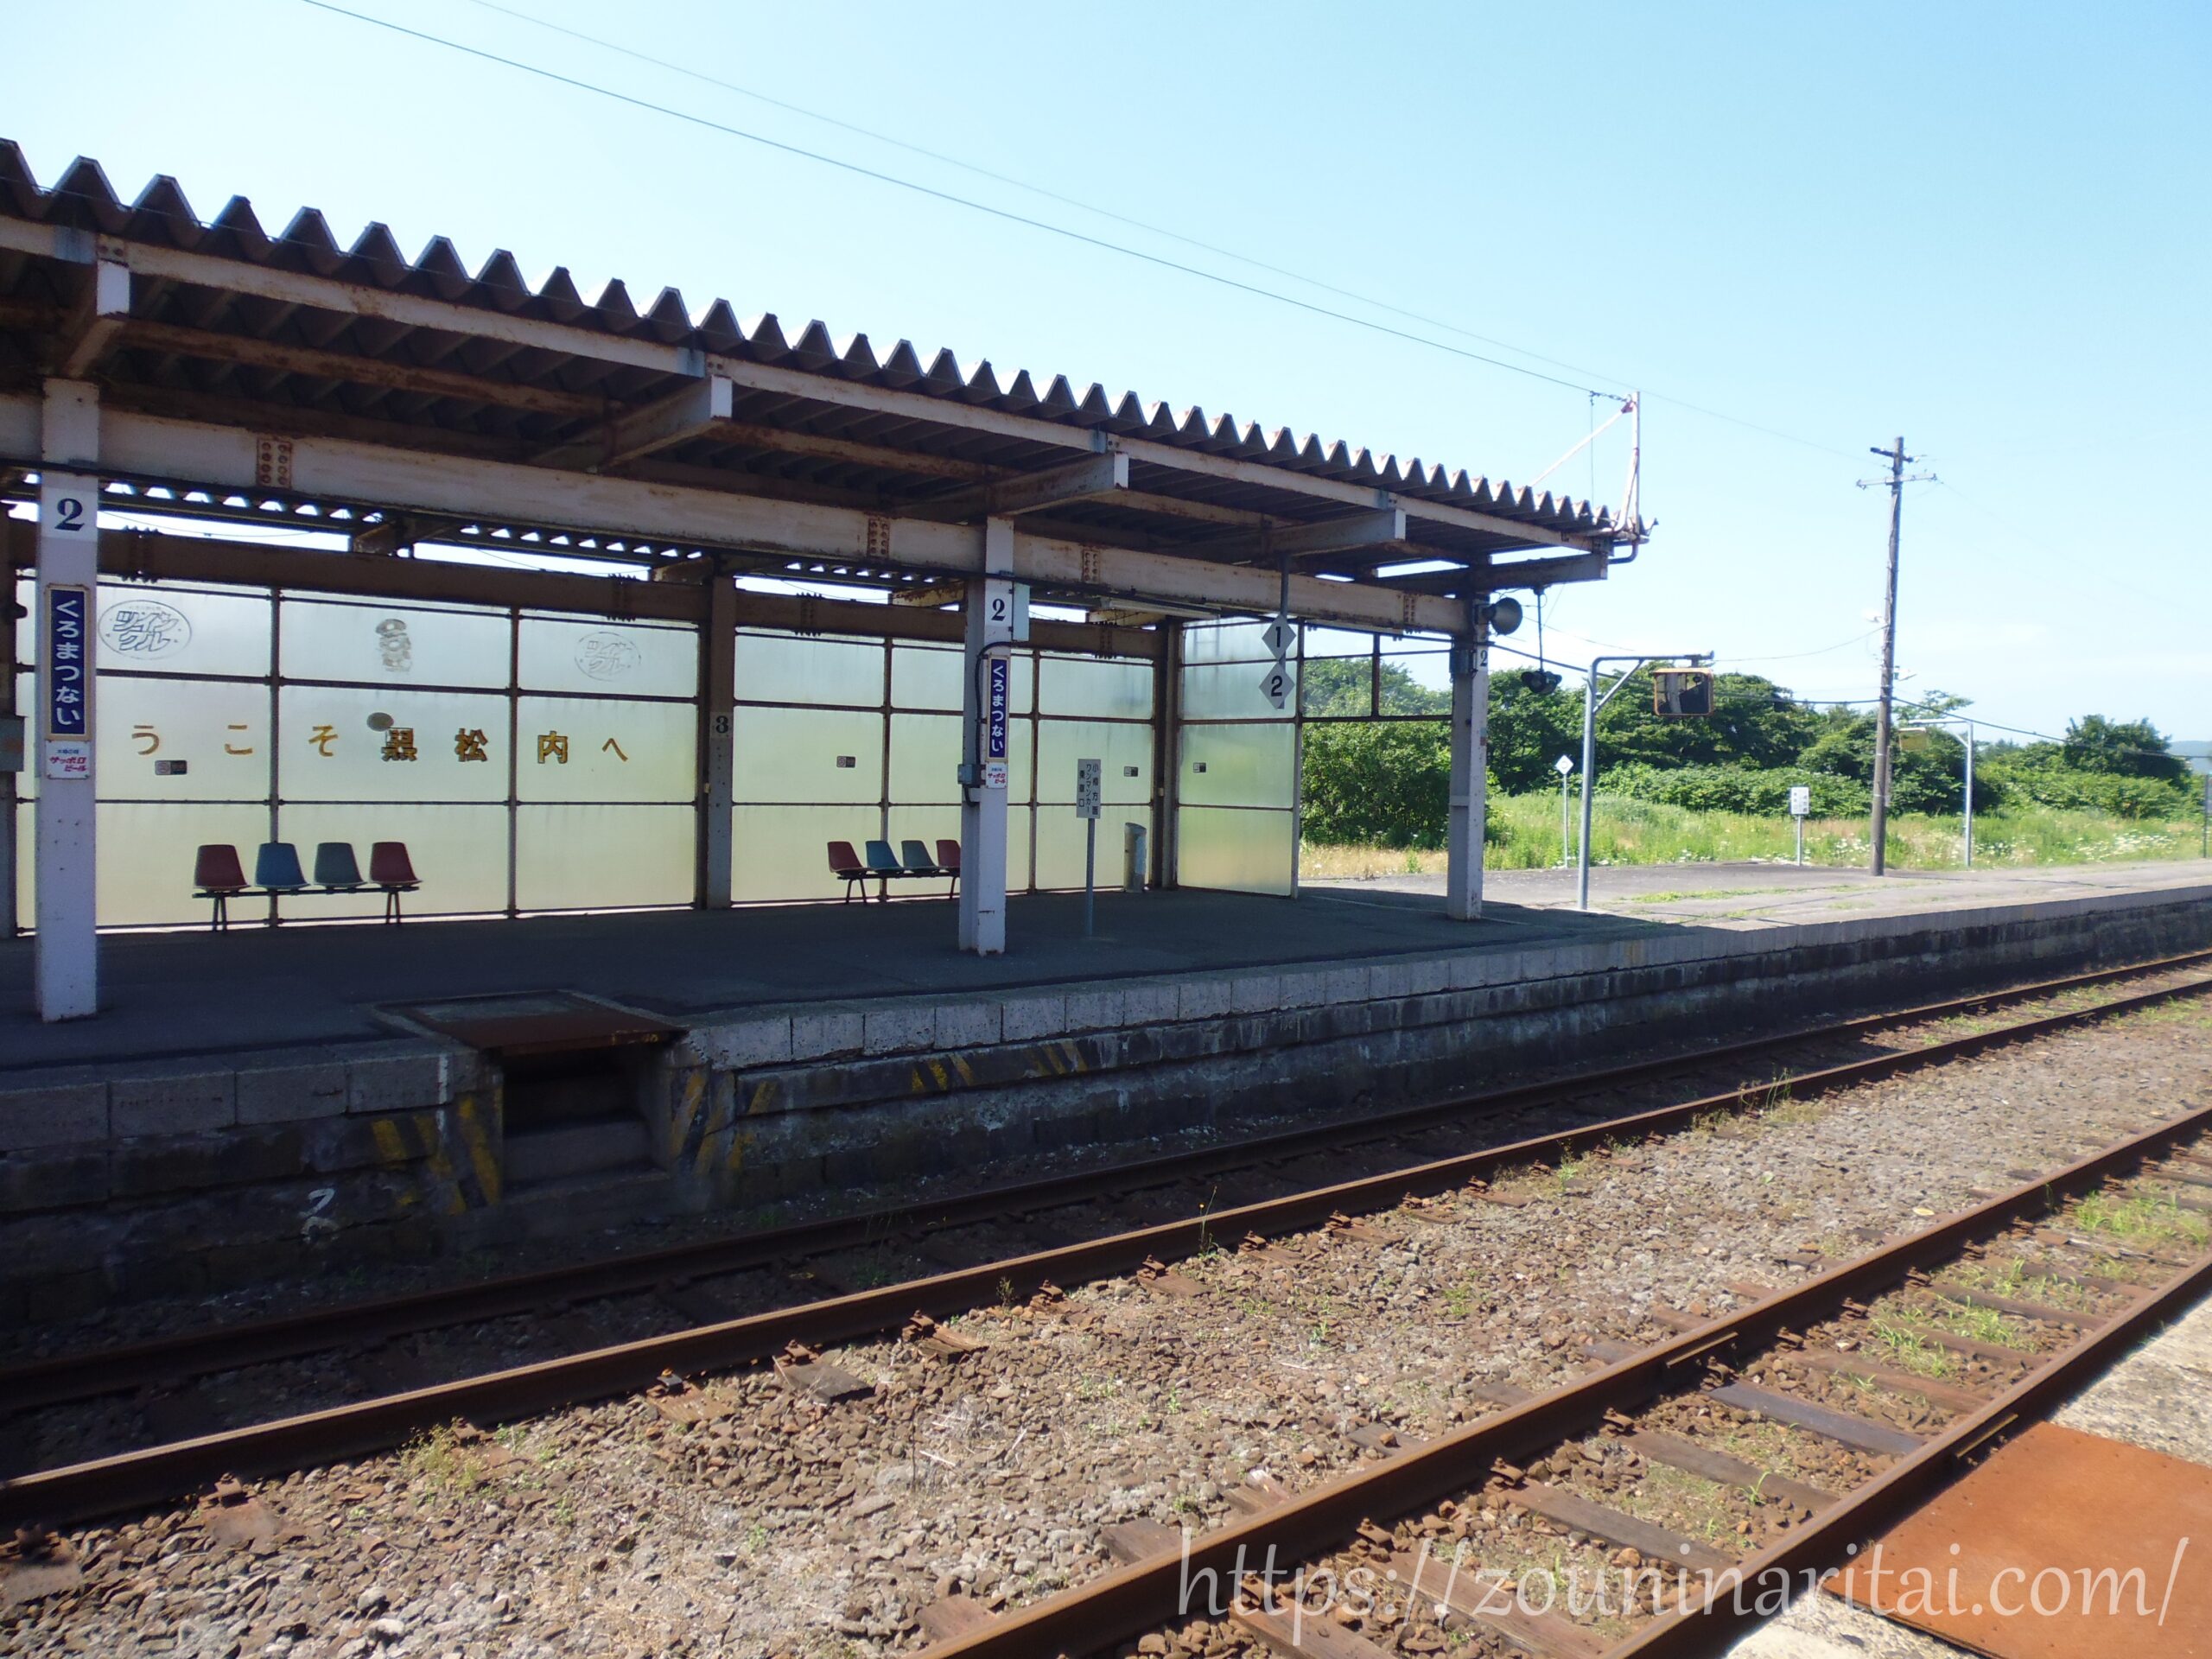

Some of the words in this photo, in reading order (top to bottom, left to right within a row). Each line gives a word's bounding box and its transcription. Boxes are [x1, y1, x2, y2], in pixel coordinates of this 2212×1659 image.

[54, 498, 85, 531] 2
[992, 599, 1006, 622] 2
[1274, 626, 1282, 648] 1
[54, 599, 80, 726] くろまつない
[1480, 650, 1488, 667] 2
[1271, 675, 1283, 697] 2
[990, 664, 1005, 753] くろまつない
[49, 756, 87, 765] サッポロ
